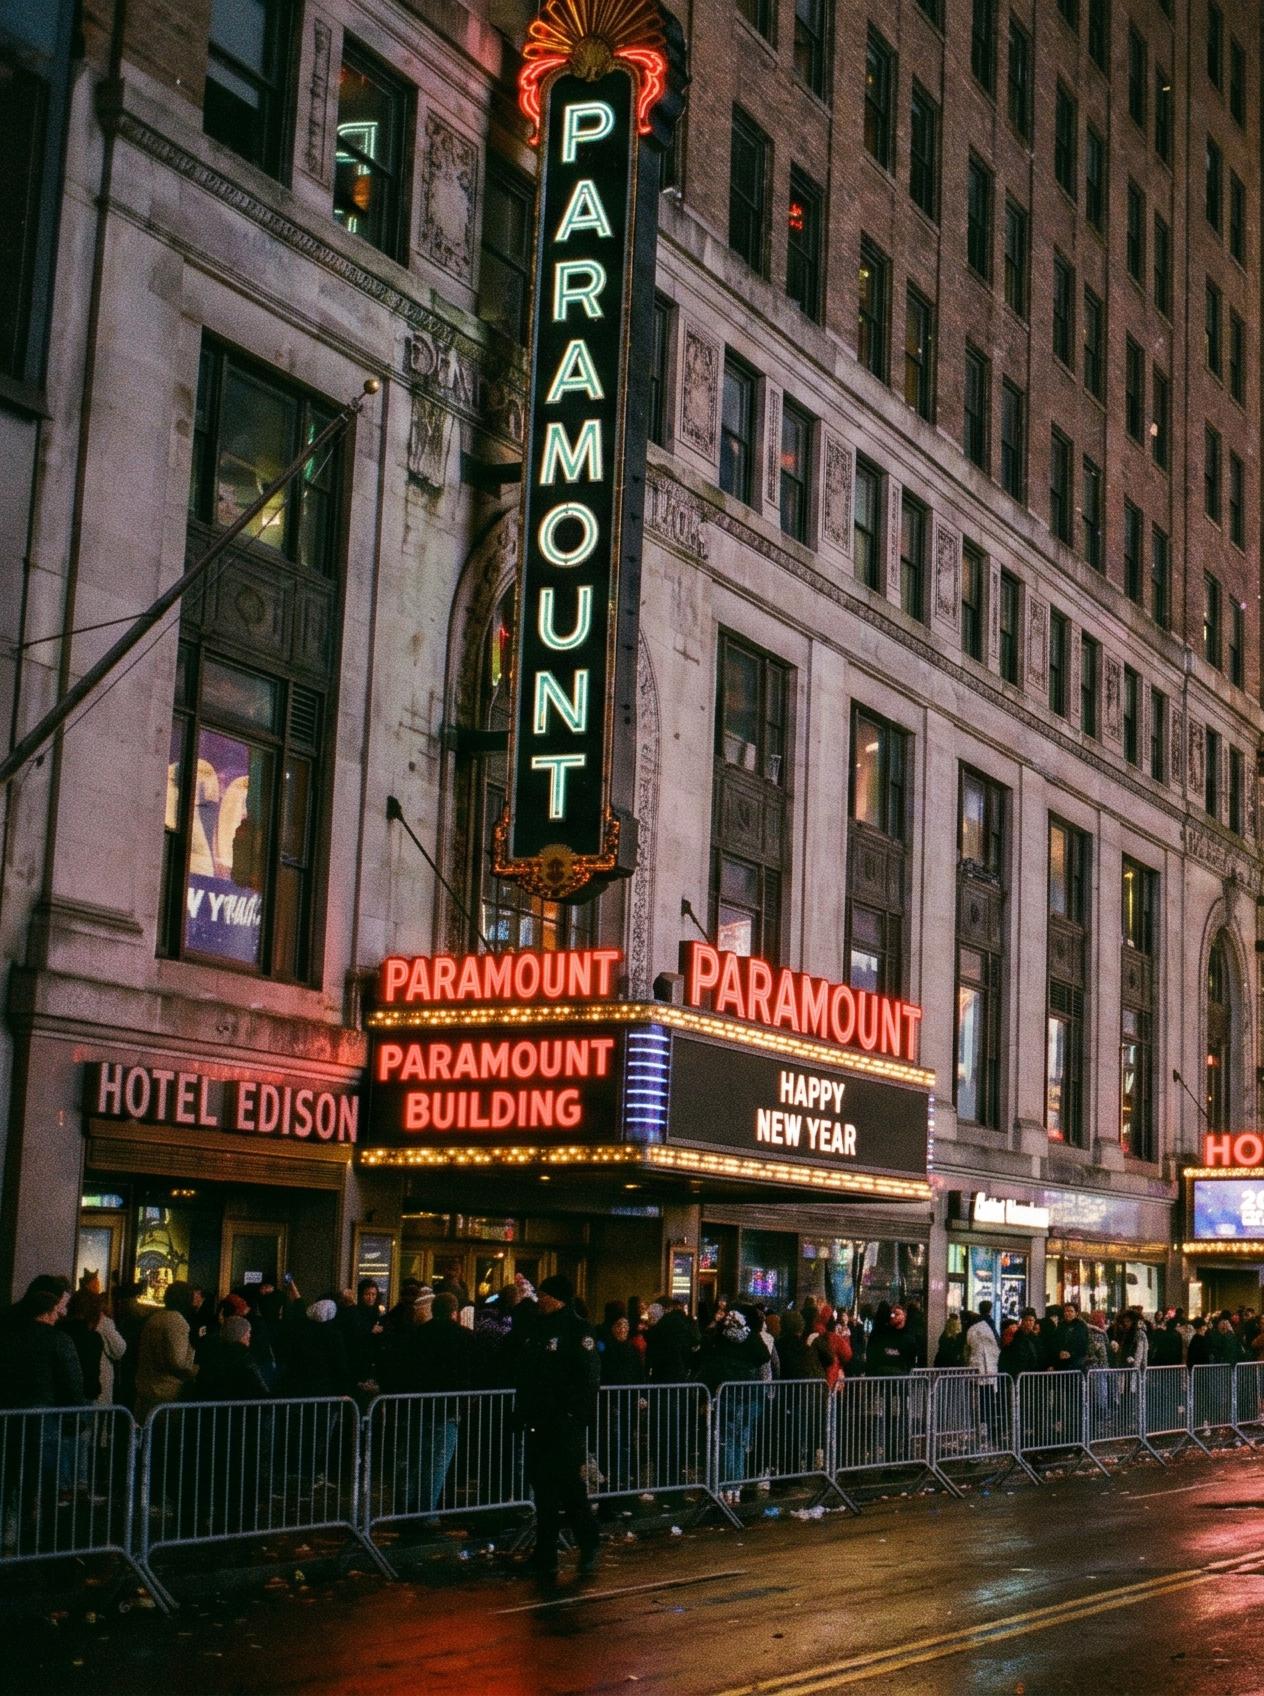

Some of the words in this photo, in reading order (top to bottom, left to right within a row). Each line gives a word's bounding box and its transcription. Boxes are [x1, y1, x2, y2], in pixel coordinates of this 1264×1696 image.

[531, 99, 615, 821] PARAMOUNT
[384, 950, 619, 1002] PARAMOUNT
[690, 941, 922, 1061] PARAMOUNT
[378, 1038, 615, 1082] PARAMOUNT
[98, 1061, 218, 1128] HOTEL
[236, 1080, 360, 1144] EDISON
[404, 1088, 583, 1130] BUILDING
[779, 1070, 846, 1114] HAPPY
[756, 1108, 803, 1147] NEW
[806, 1116, 857, 1156] YEAR
